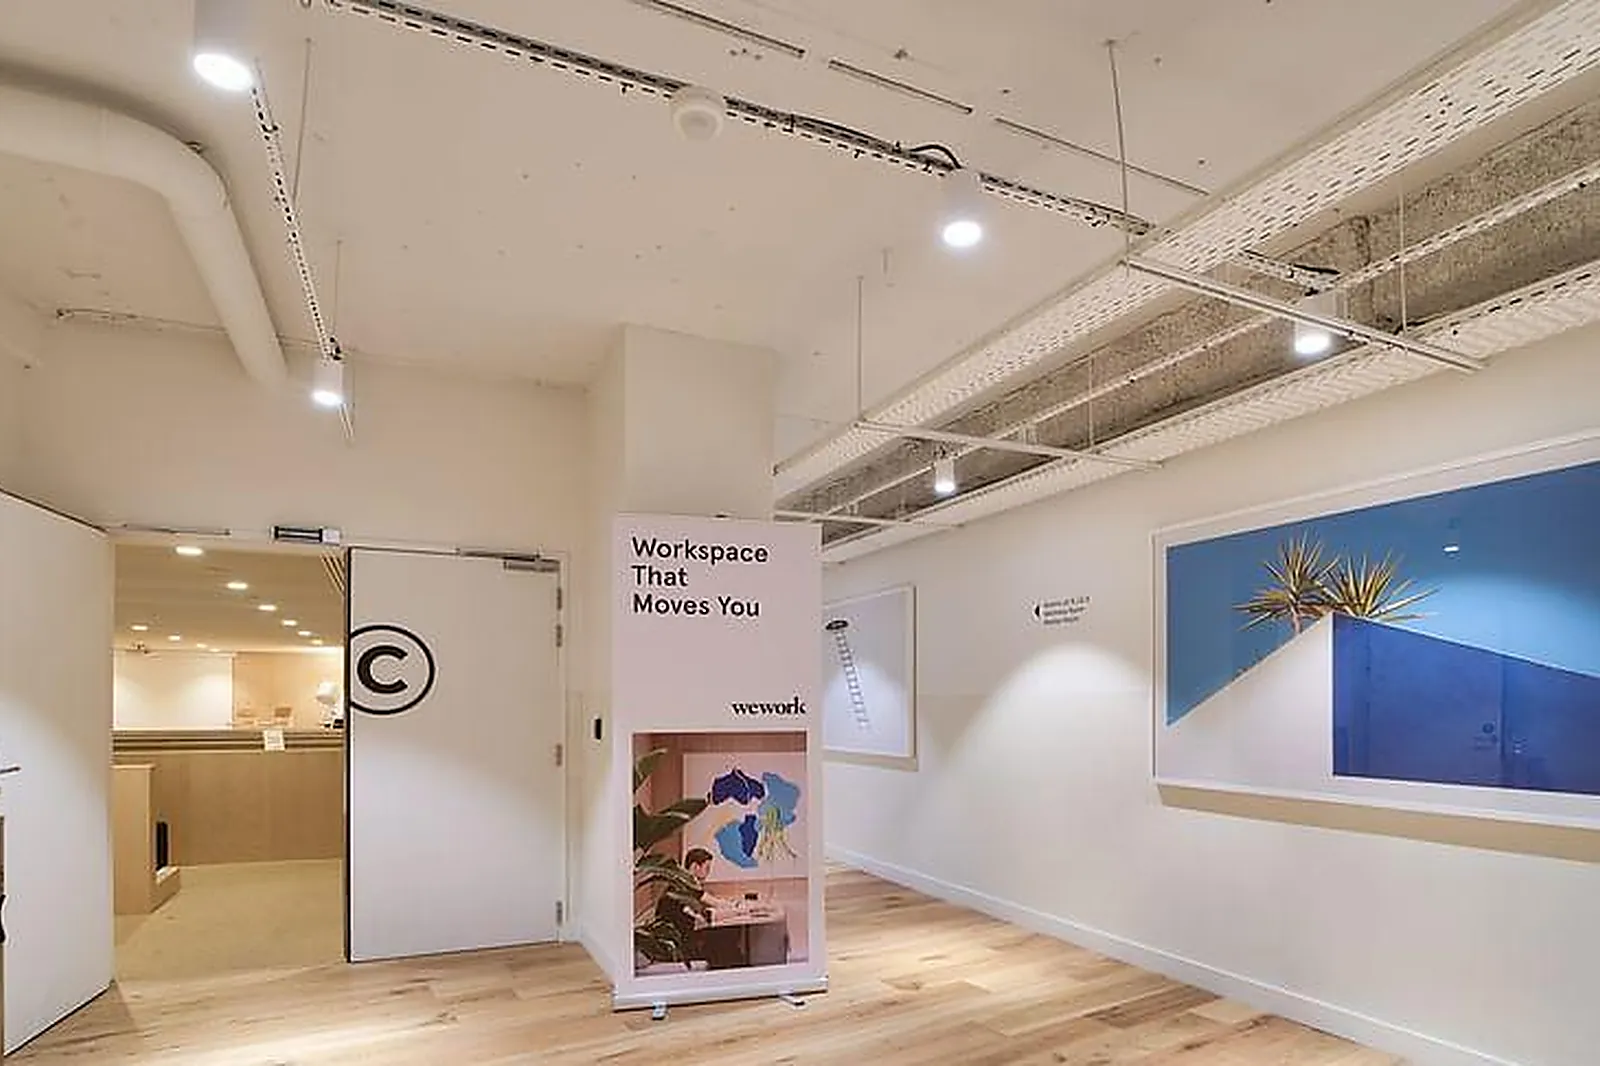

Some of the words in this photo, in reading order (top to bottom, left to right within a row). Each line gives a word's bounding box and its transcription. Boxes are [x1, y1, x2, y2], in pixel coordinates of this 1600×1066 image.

[632, 537, 768, 565] Workspace
[631, 565, 688, 587] That
[633, 593, 709, 616] Moves
[717, 596, 760, 618] You
[732, 696, 807, 715] wework
